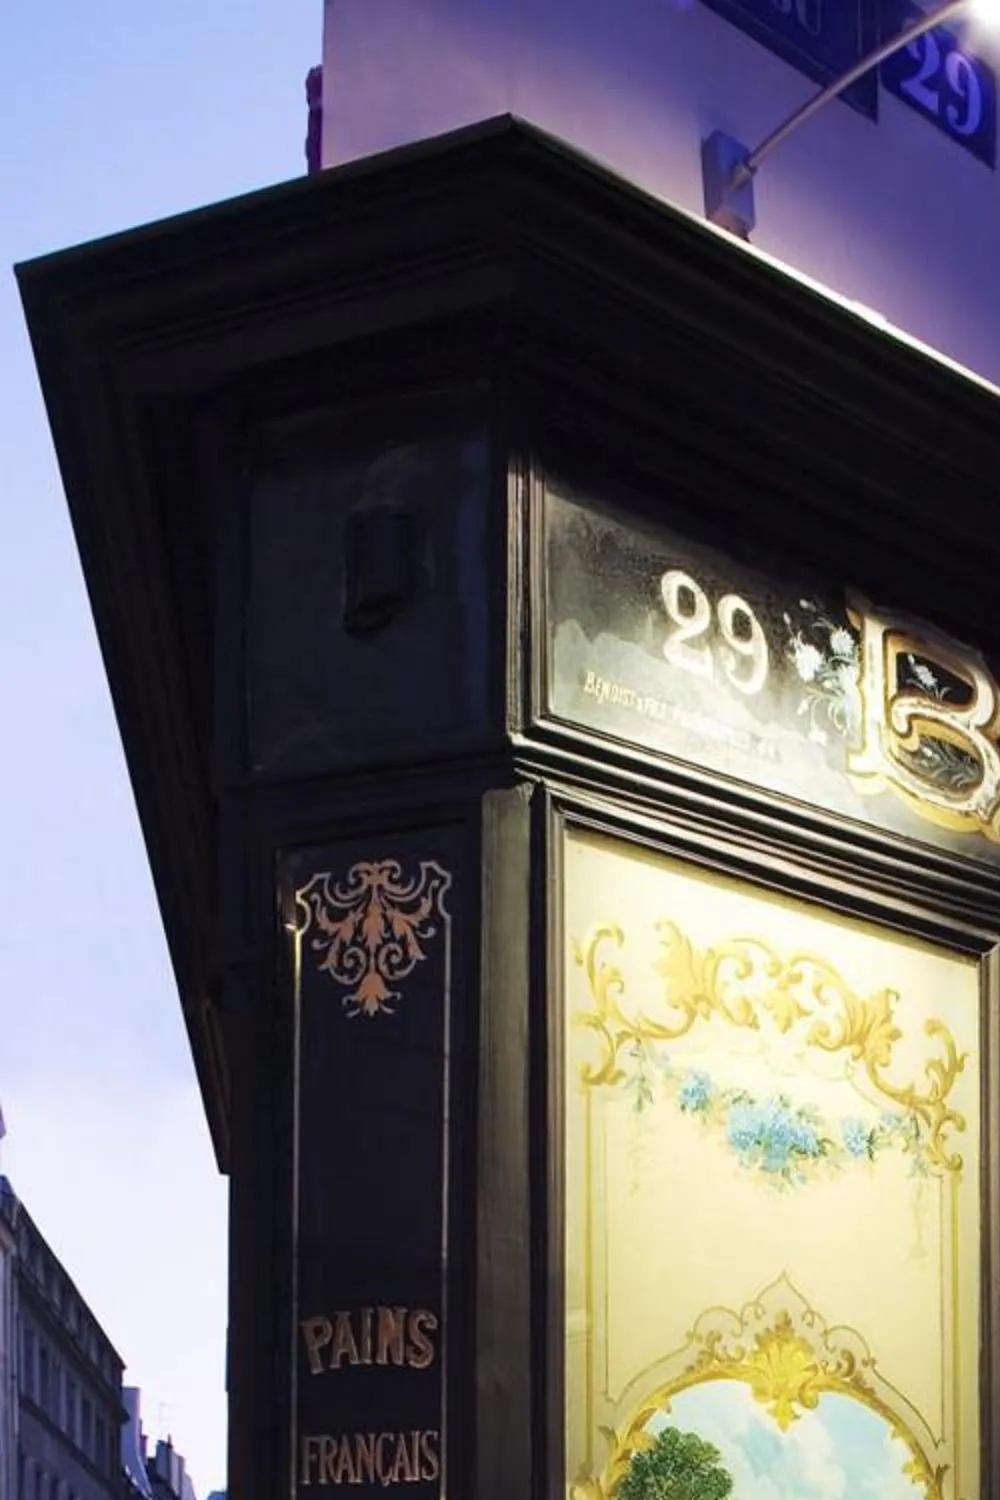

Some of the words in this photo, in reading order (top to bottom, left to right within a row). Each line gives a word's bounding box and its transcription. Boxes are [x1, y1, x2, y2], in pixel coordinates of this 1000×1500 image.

[900, 18, 982, 136] 29
[660, 569, 768, 693] 29
[301, 1307, 438, 1374] PAINS
[302, 1431, 439, 1486] FRANÇAIS
